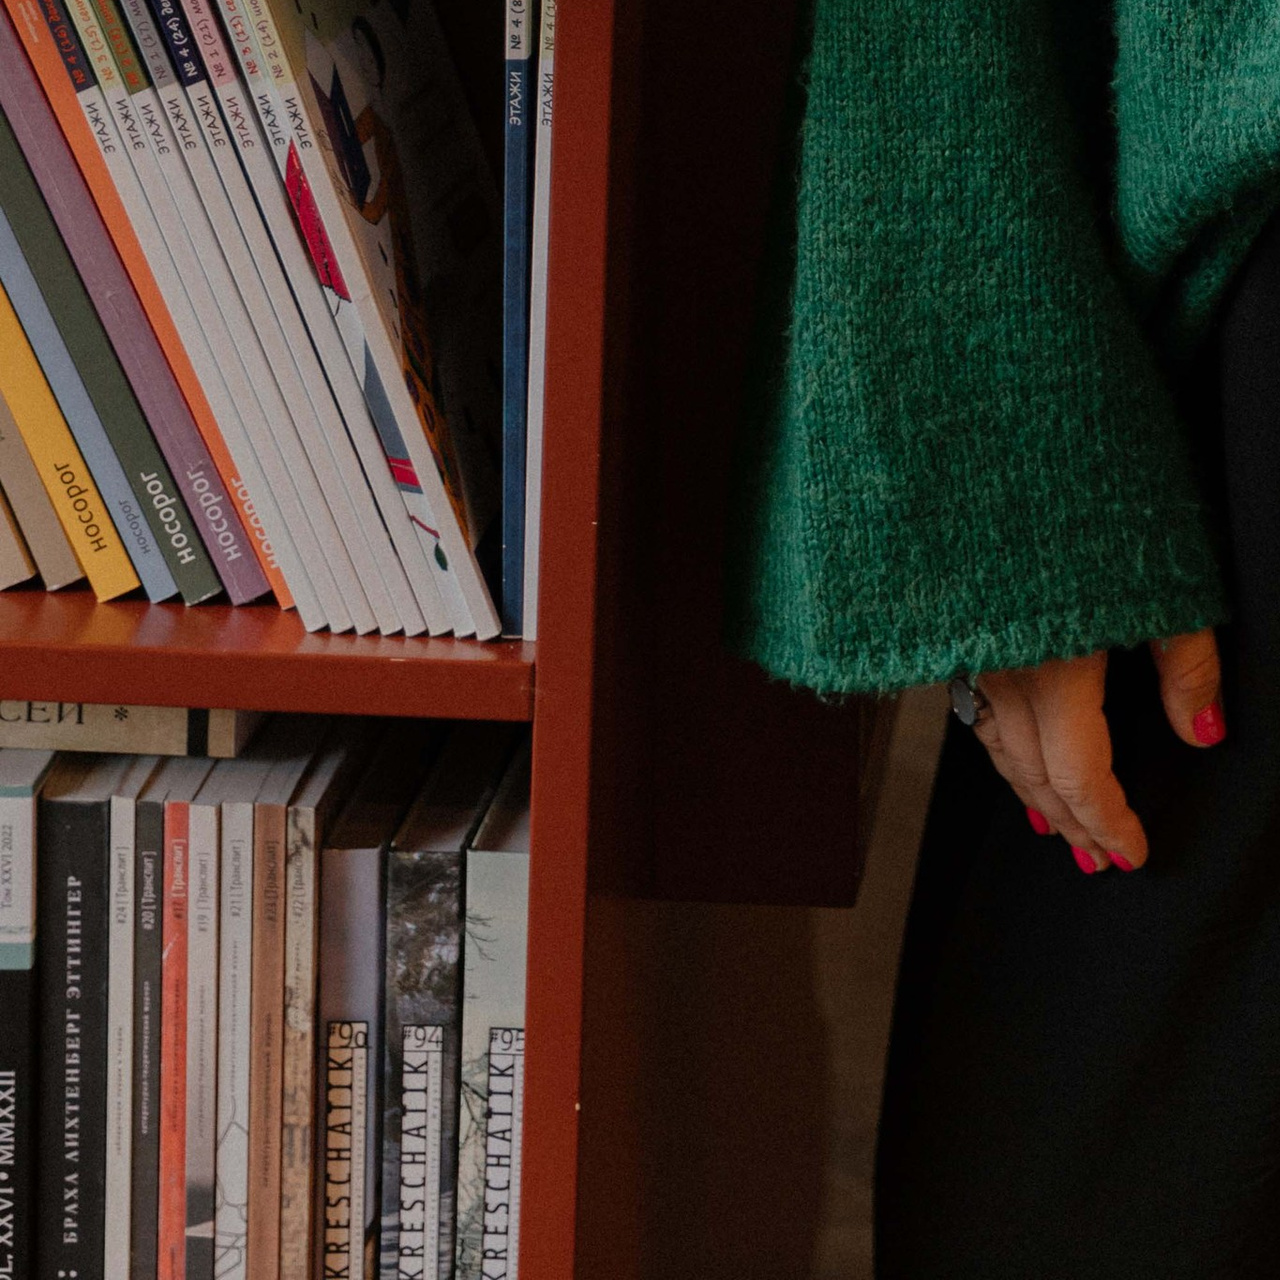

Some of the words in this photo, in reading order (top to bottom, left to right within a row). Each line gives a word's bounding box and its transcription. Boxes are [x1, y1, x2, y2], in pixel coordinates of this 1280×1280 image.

[138, 21, 157, 48] (17)
[167, 17, 188, 45] (24)
[196, 18, 217, 46] (21)
[230, 15, 250, 43] (11)
[257, 20, 276, 47] (14)
[512, 19, 523, 29] 4
[548, 21, 555, 31] 4
[85, 25, 104, 52] (15)
[179, 48, 189, 57] 4
[242, 46, 252, 55] 3
[510, 32, 522, 50] №
[545, 35, 555, 52] №
[97, 55, 107, 64] 3
[246, 59, 258, 75] №
[268, 50, 278, 59] 2
[155, 66, 167, 80] №
[184, 62, 198, 77] №
[213, 63, 226, 78] №
[272, 64, 284, 79] №
[509, 70, 523, 127] ЭТАЖИ
[542, 73, 554, 128] ЭТАЖИ
[86, 101, 115, 154] ЭТАЖИ
[116, 98, 145, 151] ЭТАЖИ
[141, 103, 170, 155] ЭТАЖИ
[167, 98, 196, 150] ЭТАЖИ
[198, 95, 226, 148] ЭТАЖИ
[226, 96, 255, 148] ЭТАЖИ
[258, 93, 285, 146] ЭТАЖИ
[284, 97, 312, 149] ЭТАЖИ
[54, 462, 108, 553] носорог
[140, 472, 196, 564] носорог
[187, 470, 242, 562] носорог
[118, 499, 151, 555] носорог
[1, 825, 13, 851] 2022
[230, 902, 242, 918] #21
[66, 875, 82, 1000] ЭТТИНГЕР
[404, 1026, 444, 1049] #94
[64, 1009, 81, 1163] ЛИХТЕНБЕРГ
[0, 1070, 16, 1166] MMXXII
[324, 1056, 353, 1280] KRESCHATIK
[399, 1060, 428, 1280] KRESCHATIK
[63, 1172, 80, 1244] БРАХА
